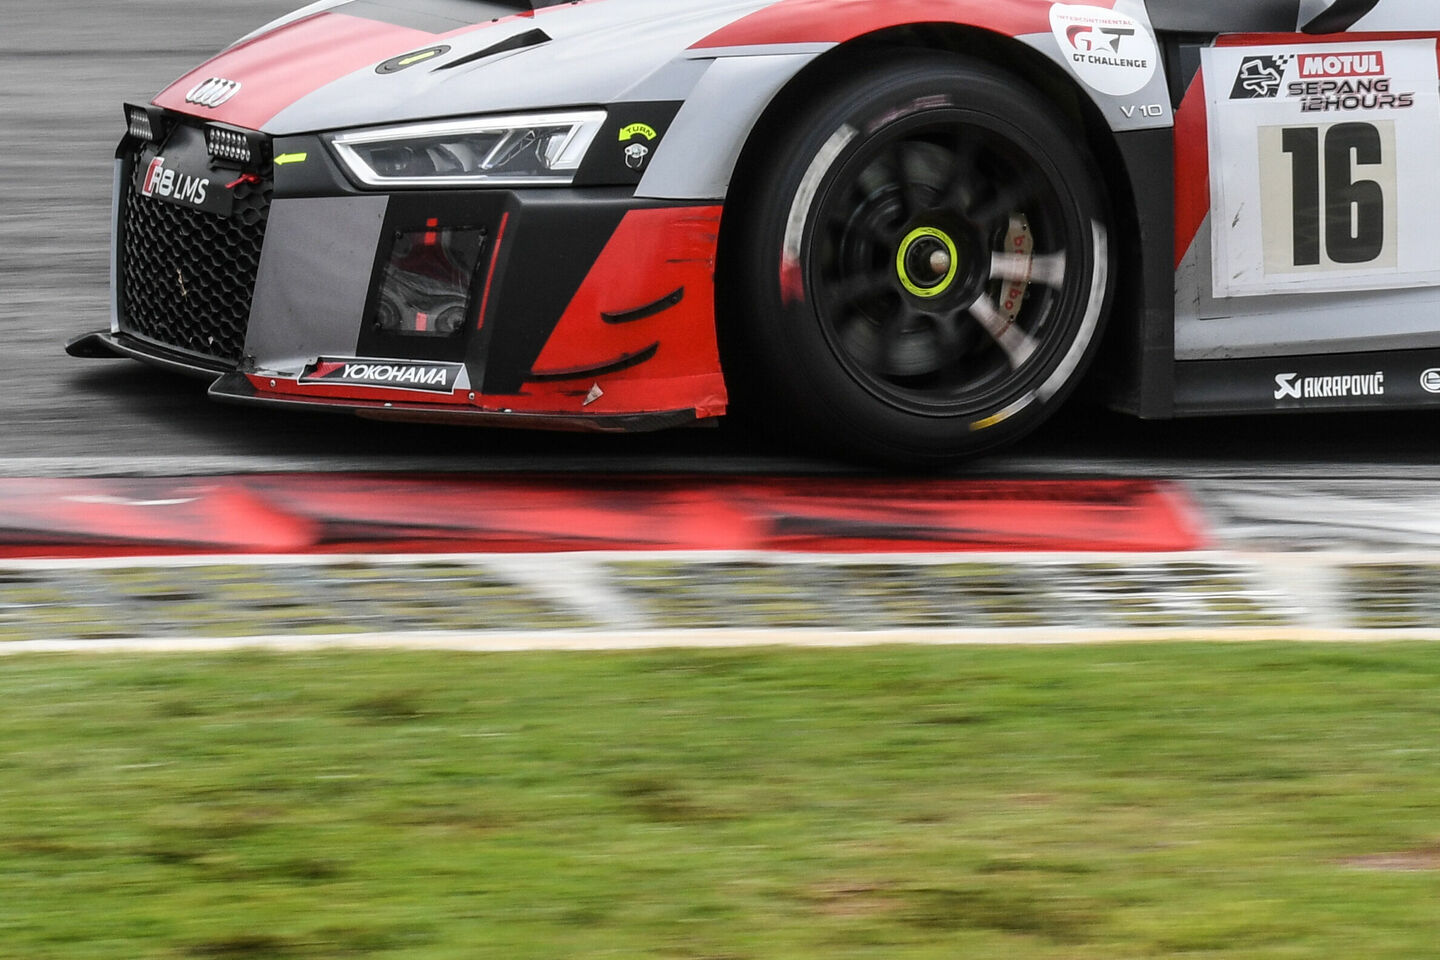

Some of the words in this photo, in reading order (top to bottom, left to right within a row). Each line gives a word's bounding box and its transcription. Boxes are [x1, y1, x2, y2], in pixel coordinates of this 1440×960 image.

[1073, 53, 1086, 63] GT
[1088, 55, 1147, 69] CHALLENGE
[1303, 55, 1381, 75] MOTUL
[1287, 78, 1390, 97] SEPANG
[1121, 105, 1135, 117] V
[1139, 104, 1163, 117] 10
[626, 126, 653, 136] TURN
[147, 165, 174, 196] R8
[174, 173, 209, 204] LMS
[1282, 122, 1384, 267] 16
[342, 364, 447, 385] YOKOHAMA
